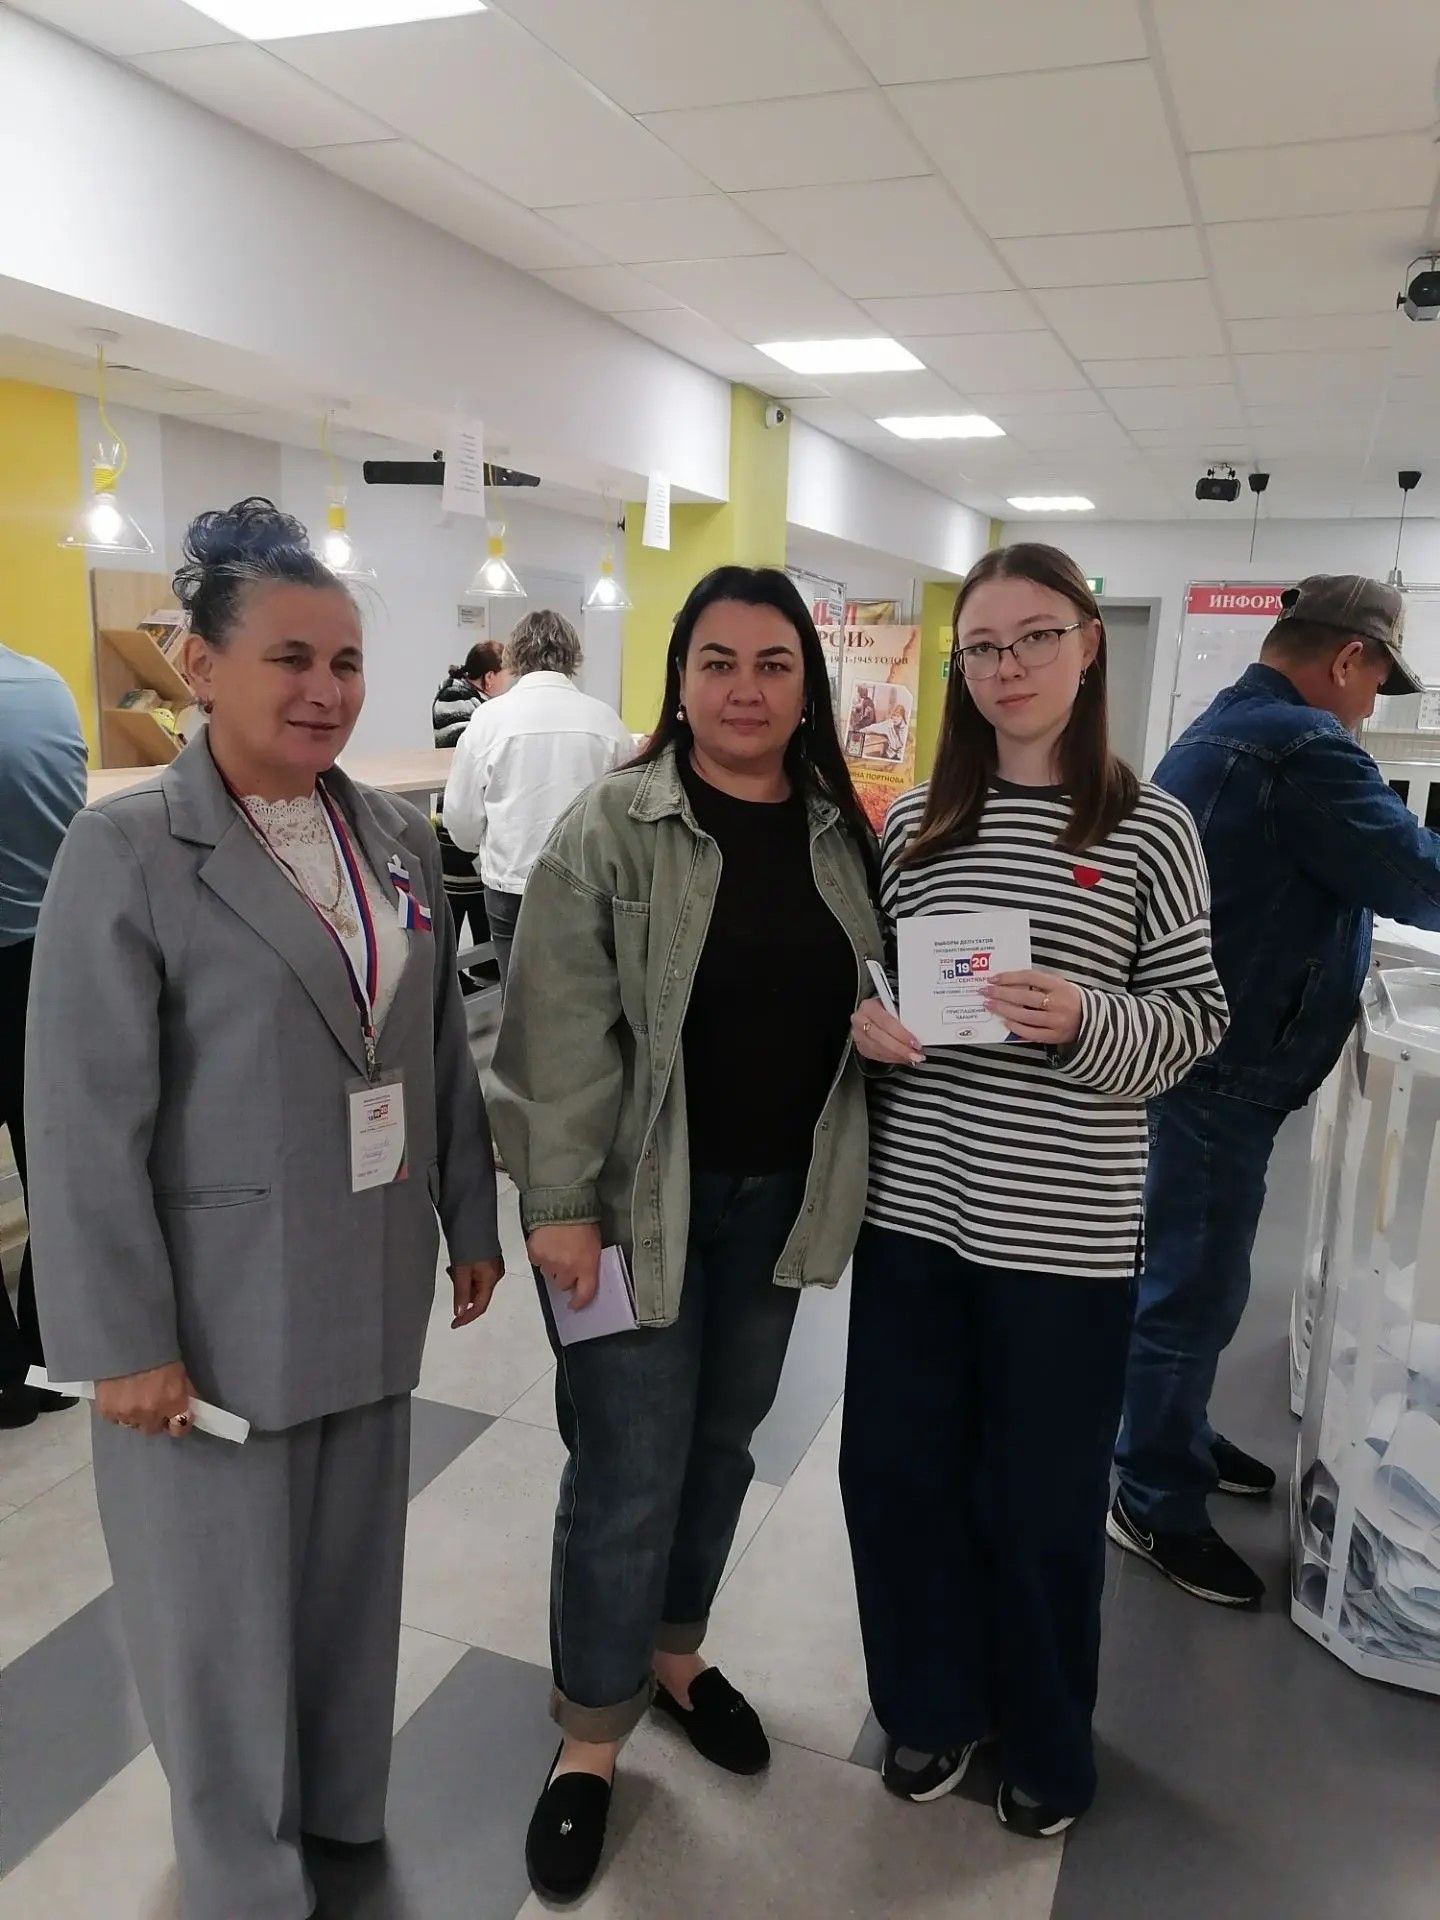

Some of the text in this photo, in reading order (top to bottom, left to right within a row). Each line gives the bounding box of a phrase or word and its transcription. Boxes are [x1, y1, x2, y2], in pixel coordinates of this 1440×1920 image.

[818, 631, 875, 648] РОИ»
[830, 656, 872, 664] 191-1945
[942, 957, 988, 979] 18 19 20
